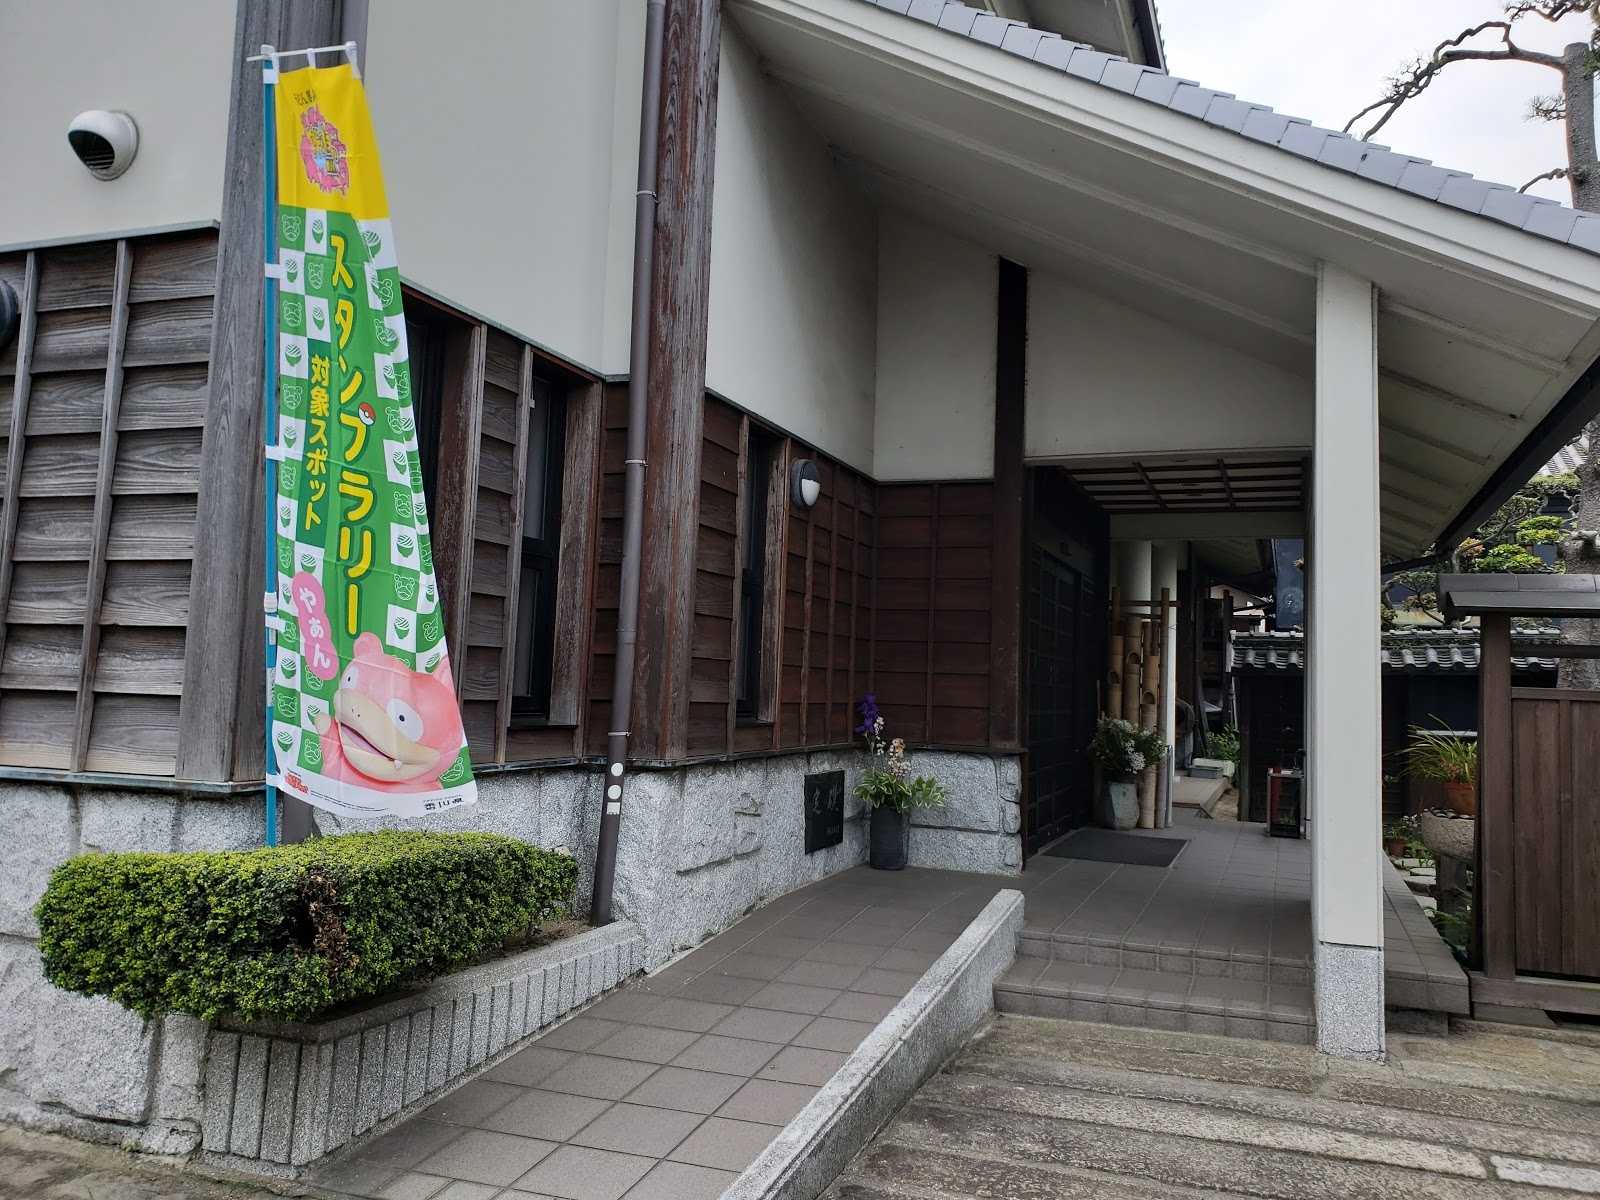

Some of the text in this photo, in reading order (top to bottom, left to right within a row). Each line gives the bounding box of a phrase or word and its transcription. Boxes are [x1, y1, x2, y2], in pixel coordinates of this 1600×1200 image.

[305, 354, 331, 531] 対象スポット
[331, 234, 374, 636] スタンプラリー
